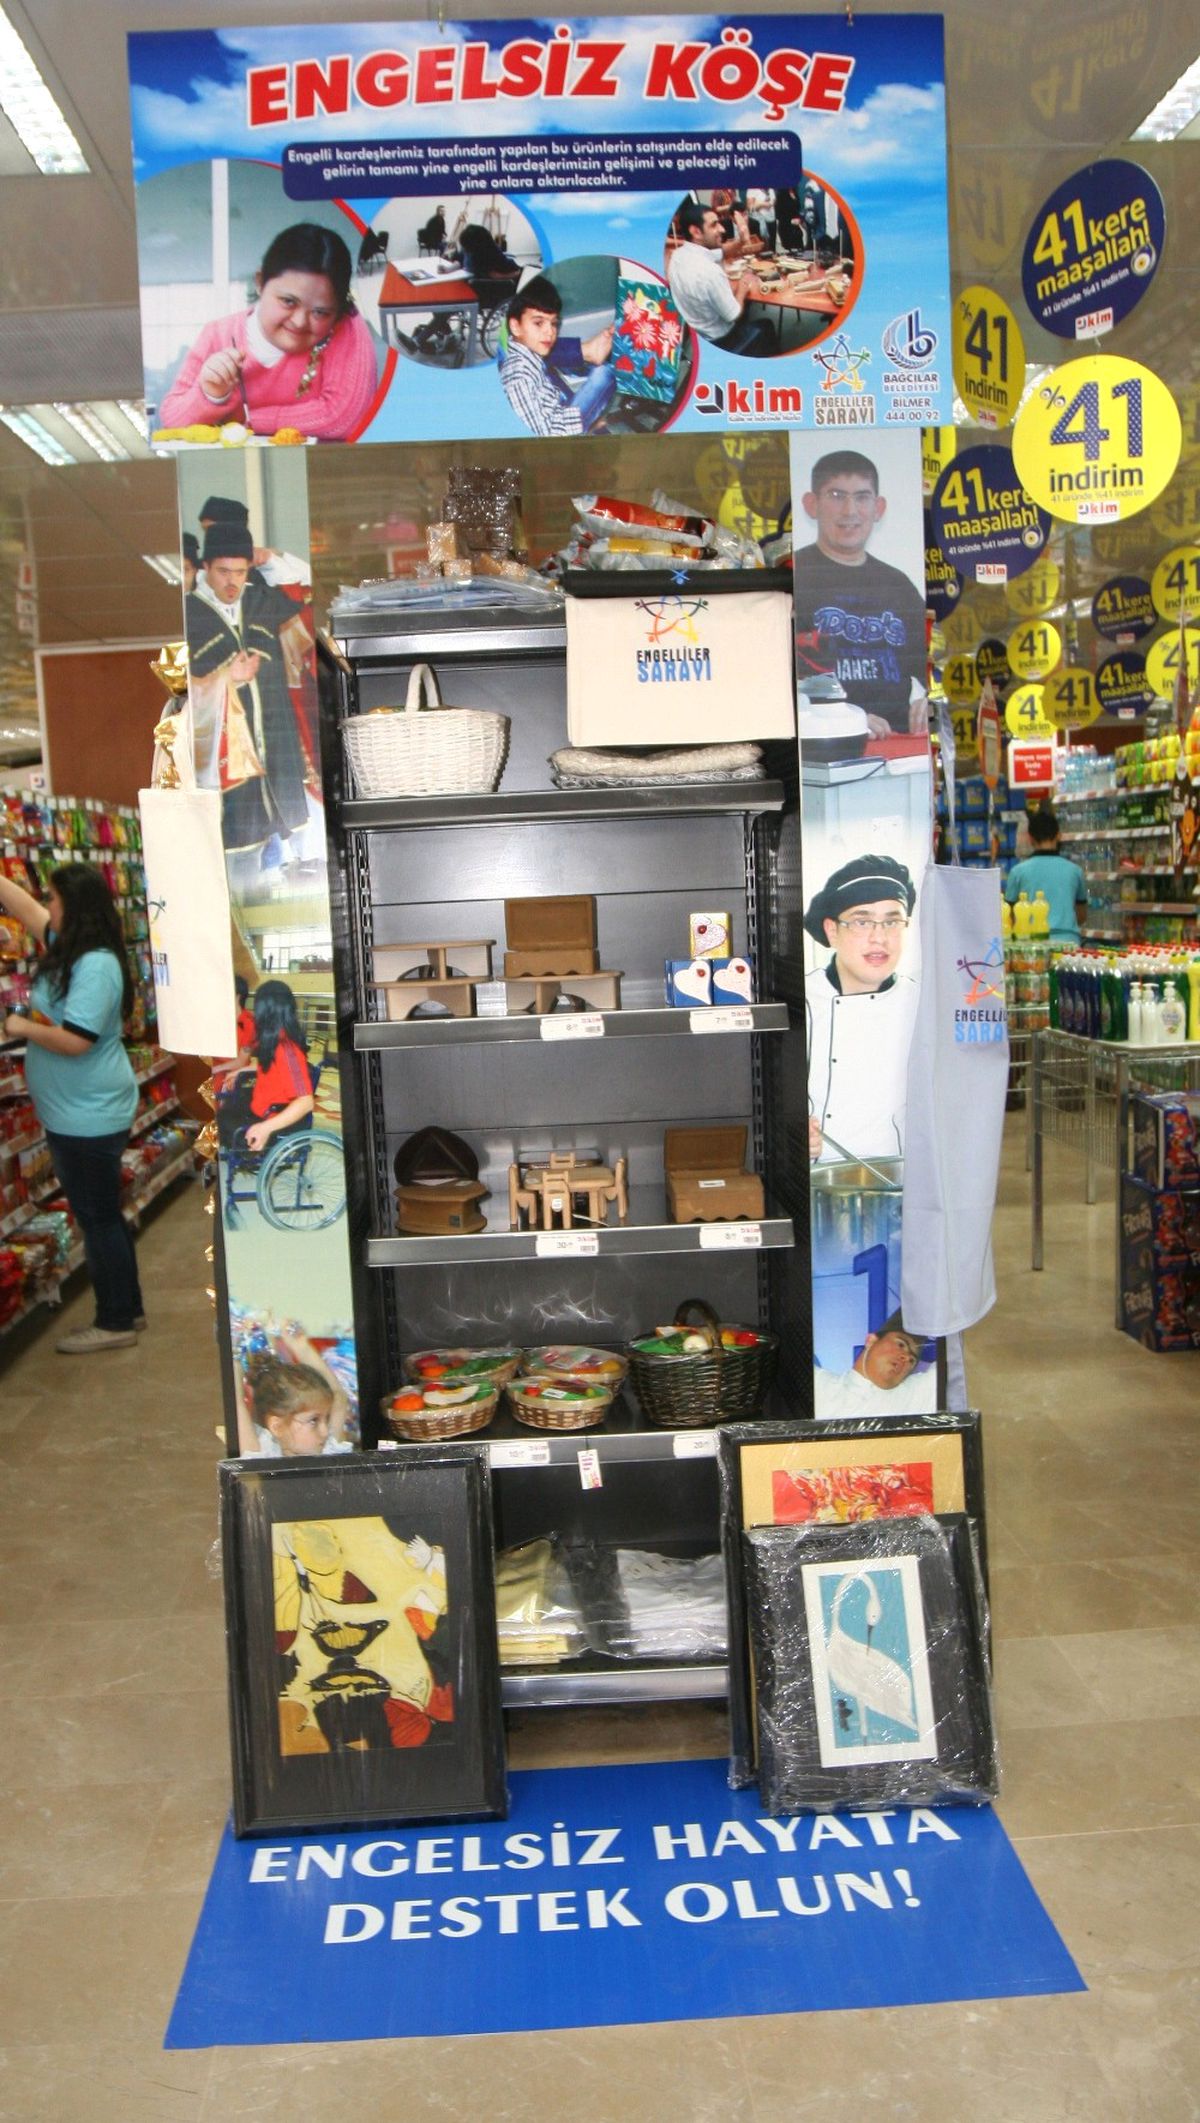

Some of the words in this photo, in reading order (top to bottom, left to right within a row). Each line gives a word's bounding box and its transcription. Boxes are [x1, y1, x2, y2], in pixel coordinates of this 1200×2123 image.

[248, 27, 628, 128] ENGELSİZ
[644, 28, 854, 121] KÖŞE
[288, 147, 332, 165] Engelli
[336, 145, 424, 163] kardeşlerimiz
[428, 144, 496, 158] tarafından
[500, 142, 547, 157] yapılan
[551, 141, 568, 154] bu
[572, 140, 632, 154] ürünlerin
[636, 140, 701, 155] satışından
[705, 139, 733, 152] elde
[737, 137, 790, 151] edilecek
[323, 164, 365, 180] gelirin
[369, 164, 418, 177] tamamı
[422, 163, 449, 178] yine
[453, 160, 498, 175] engelli
[501, 156, 600, 173] kardeşlerimizin
[604, 155, 654, 173] gelişimi
[658, 156, 673, 168] ve
[677, 154, 730, 171] geleceği
[734, 154, 757, 170] için
[460, 178, 487, 191] yine
[491, 176, 534, 189] onlara
[537, 174, 627, 189] aktarılacaktır.
[1033, 199, 1088, 267] 41
[1088, 198, 1146, 246] kere
[1036, 218, 1151, 300] maaşallah!
[1087, 311, 1112, 327] kim
[884, 373, 938, 383] BAĞCILAR
[884, 383, 938, 392] BELEDİYESİ
[964, 372, 1008, 406] indirim
[727, 381, 801, 413] kim
[815, 396, 874, 408] ENGELLİLER
[892, 398, 931, 408] BİLMER
[816, 407, 875, 425] SARAYI
[886, 411, 905, 421] 444
[908, 411, 922, 421] 00
[925, 411, 939, 420] 92
[1050, 463, 1144, 493] indirim
[940, 467, 986, 516] 41
[1091, 503, 1118, 514] kim
[943, 505, 1039, 539] maaşallah!
[985, 566, 1006, 576] kim
[1096, 587, 1124, 612] 41
[636, 646, 711, 663] ENGELLİLER
[1018, 658, 1049, 669] indirim
[637, 659, 712, 683] SARAYI
[1099, 662, 1125, 687] 41
[1055, 707, 1091, 719] indirim
[248, 1821, 624, 1884] ENGELSİZ
[652, 1809, 962, 1860] HAYATA
[323, 1888, 643, 1944] DESTEK
[664, 1868, 921, 1922] OLUN!
